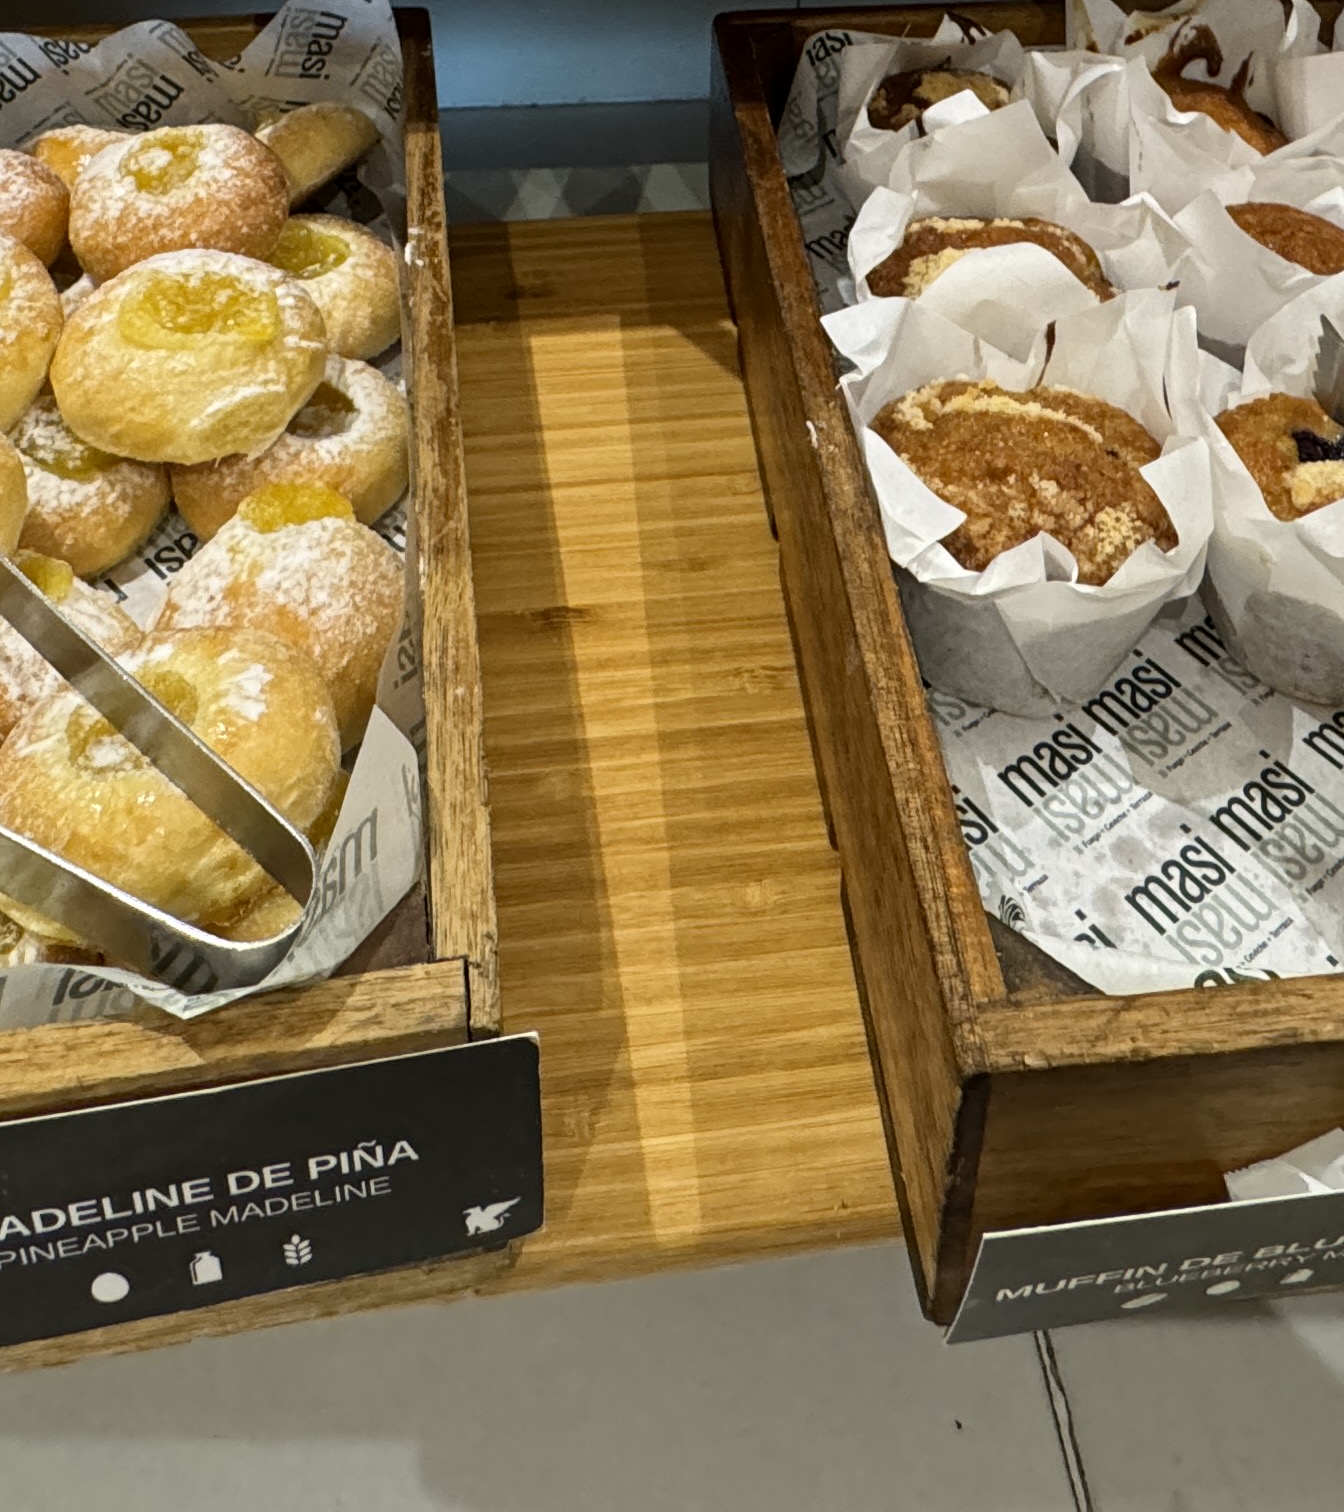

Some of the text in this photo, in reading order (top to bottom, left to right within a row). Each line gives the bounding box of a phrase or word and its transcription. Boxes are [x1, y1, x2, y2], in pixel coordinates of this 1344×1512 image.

[38, 39, 92, 76] asi
[298, 10, 349, 80] masi
[143, 532, 201, 581] asi
[1081, 648, 1183, 737] masi
[996, 713, 1104, 808] masi
[1208, 749, 1316, 853] masi
[1124, 823, 1237, 937] masi
[226, 1161, 294, 1197] DE
[307, 1139, 420, 1181] PIÑA
[209, 1175, 393, 1229] MADELINE
[994, 1261, 1171, 1305] MUFFIN
[1178, 1249, 1246, 1273] DE
[1113, 1253, 1322, 1295] BLUEBERRY
